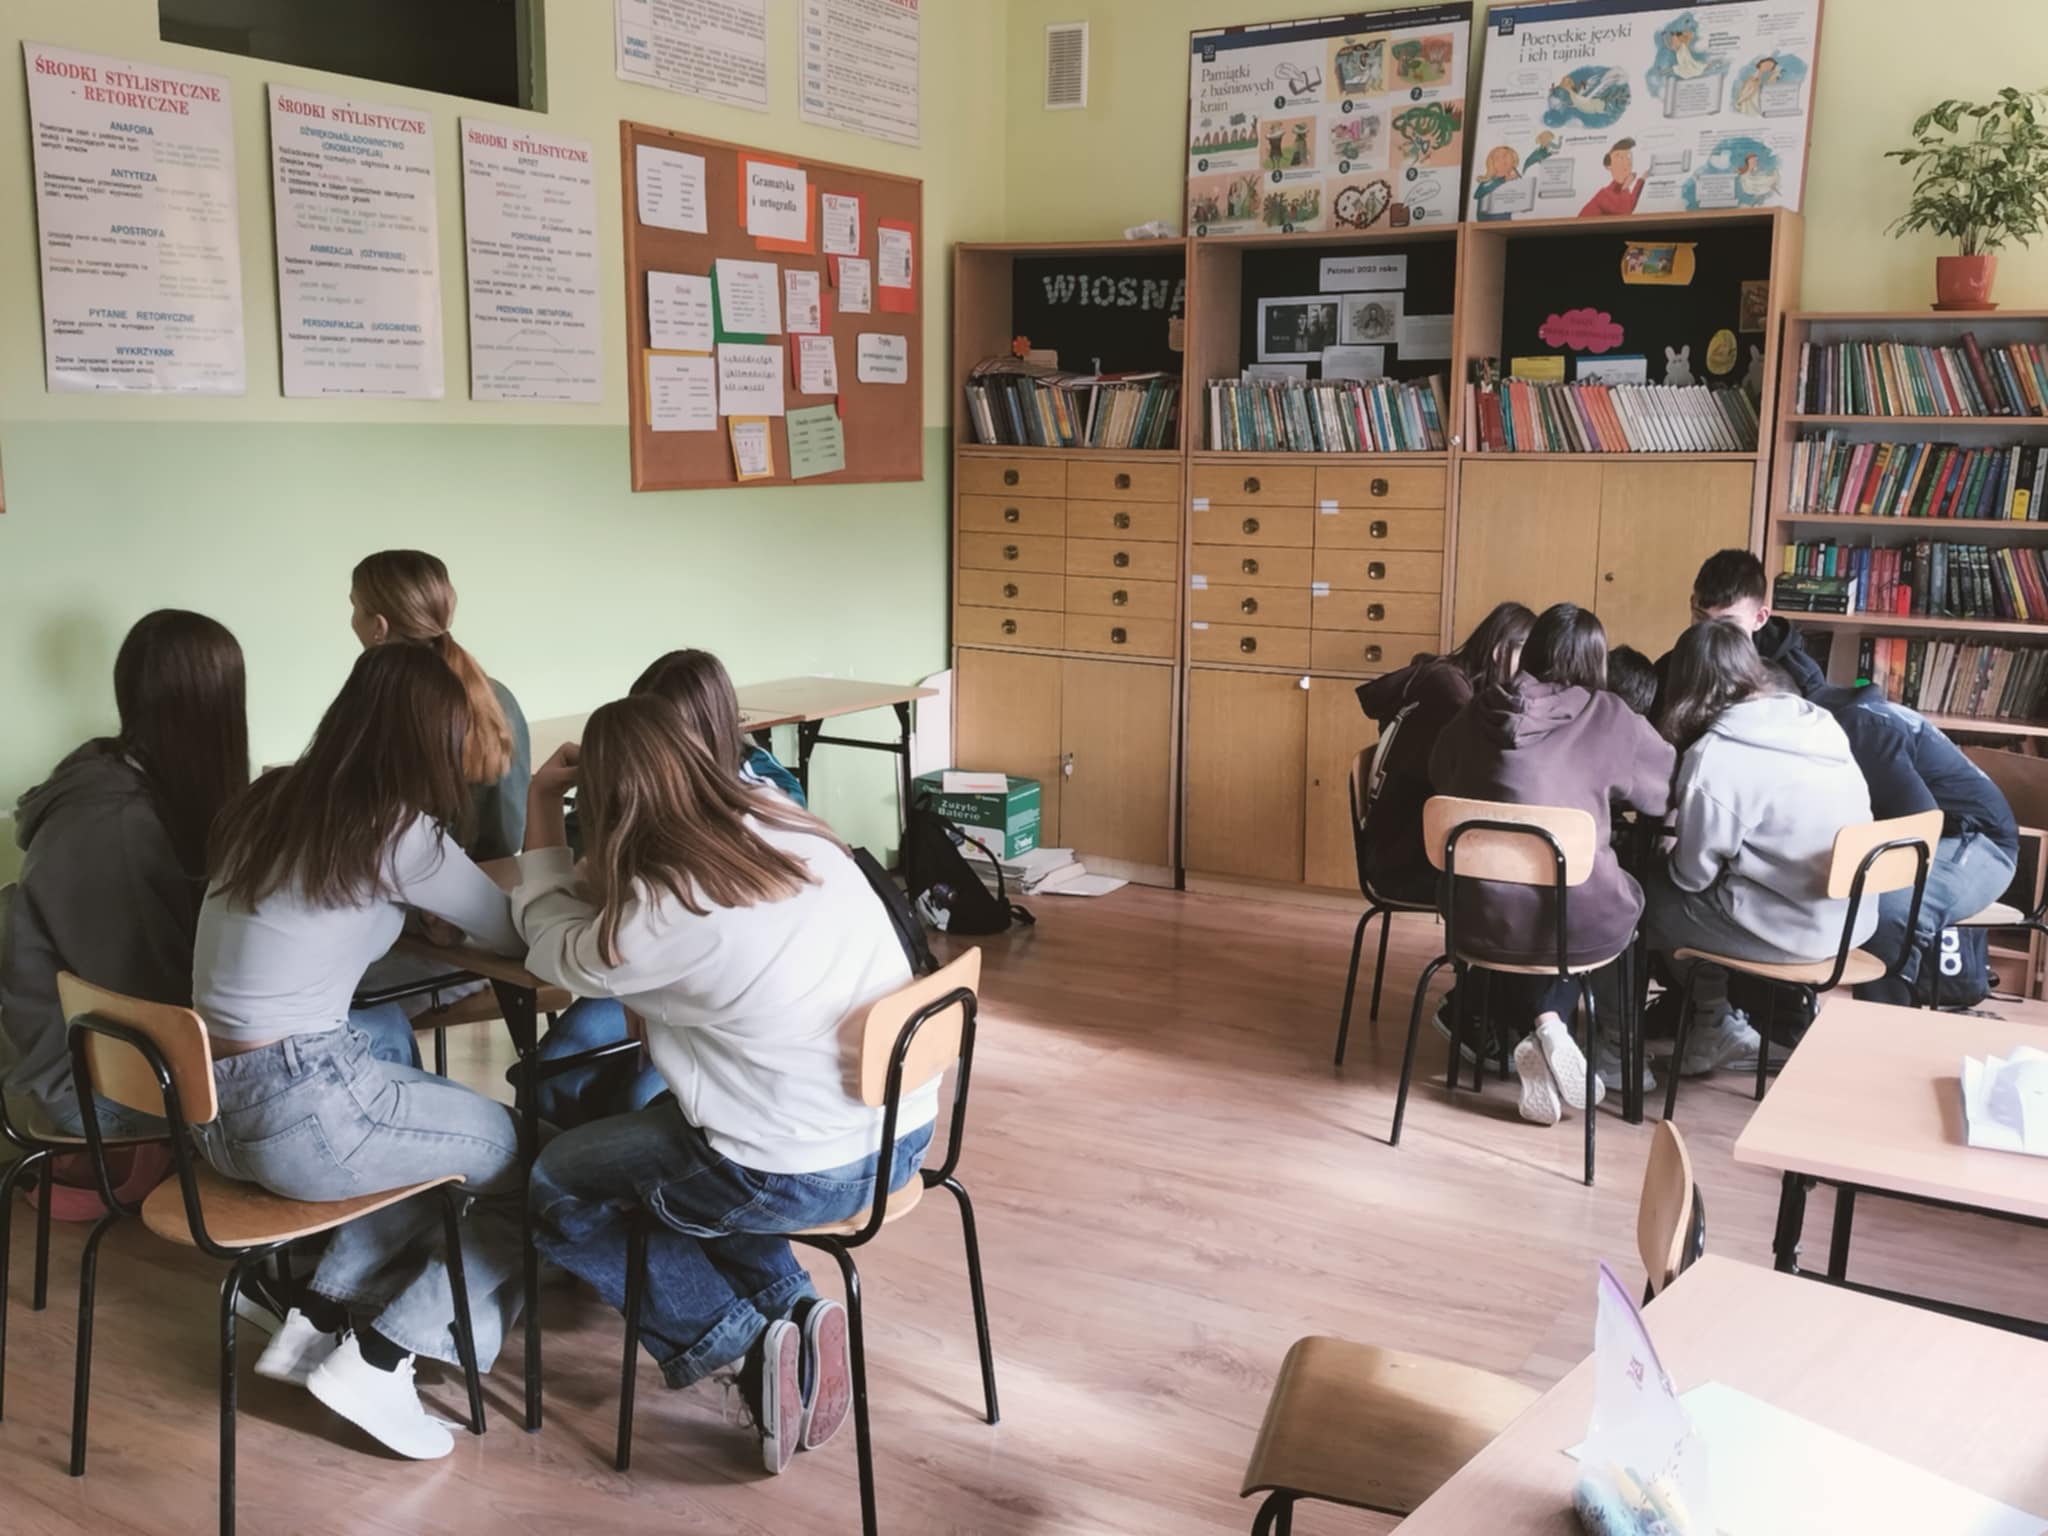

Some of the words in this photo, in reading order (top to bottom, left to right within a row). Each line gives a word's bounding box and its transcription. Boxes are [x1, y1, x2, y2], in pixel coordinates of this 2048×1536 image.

[1522, 30, 1587, 48] Poetyckie
[1589, 24, 1632, 43] języki
[1520, 50, 1524, 63] i
[1528, 48, 1548, 63] ich
[1553, 45, 1596, 62] tajniki
[35, 56, 97, 82] ŚRODKI
[106, 70, 221, 102] STYLISTYCZNE
[1202, 64, 1250, 83] Pamiątki
[1200, 89, 1207, 98] z
[1210, 78, 1274, 97] baśniowych
[84, 86, 190, 115] RETORYCZNE
[1200, 100, 1229, 113] krain
[278, 96, 325, 119] ŚRODKI
[332, 107, 426, 135] STYLISTYCZNE
[110, 121, 154, 136] ANAFORA
[468, 129, 507, 150] ŚRODKI
[512, 140, 589, 163] STYLISTYCZNE
[110, 168, 158, 183] ANTYTEZA
[752, 174, 795, 193] Gramatyka
[752, 196, 755, 207] i
[759, 197, 797, 212] ortografia
[110, 225, 166, 238] APOSTROFA
[1043, 274, 1186, 311] WIOSNA
